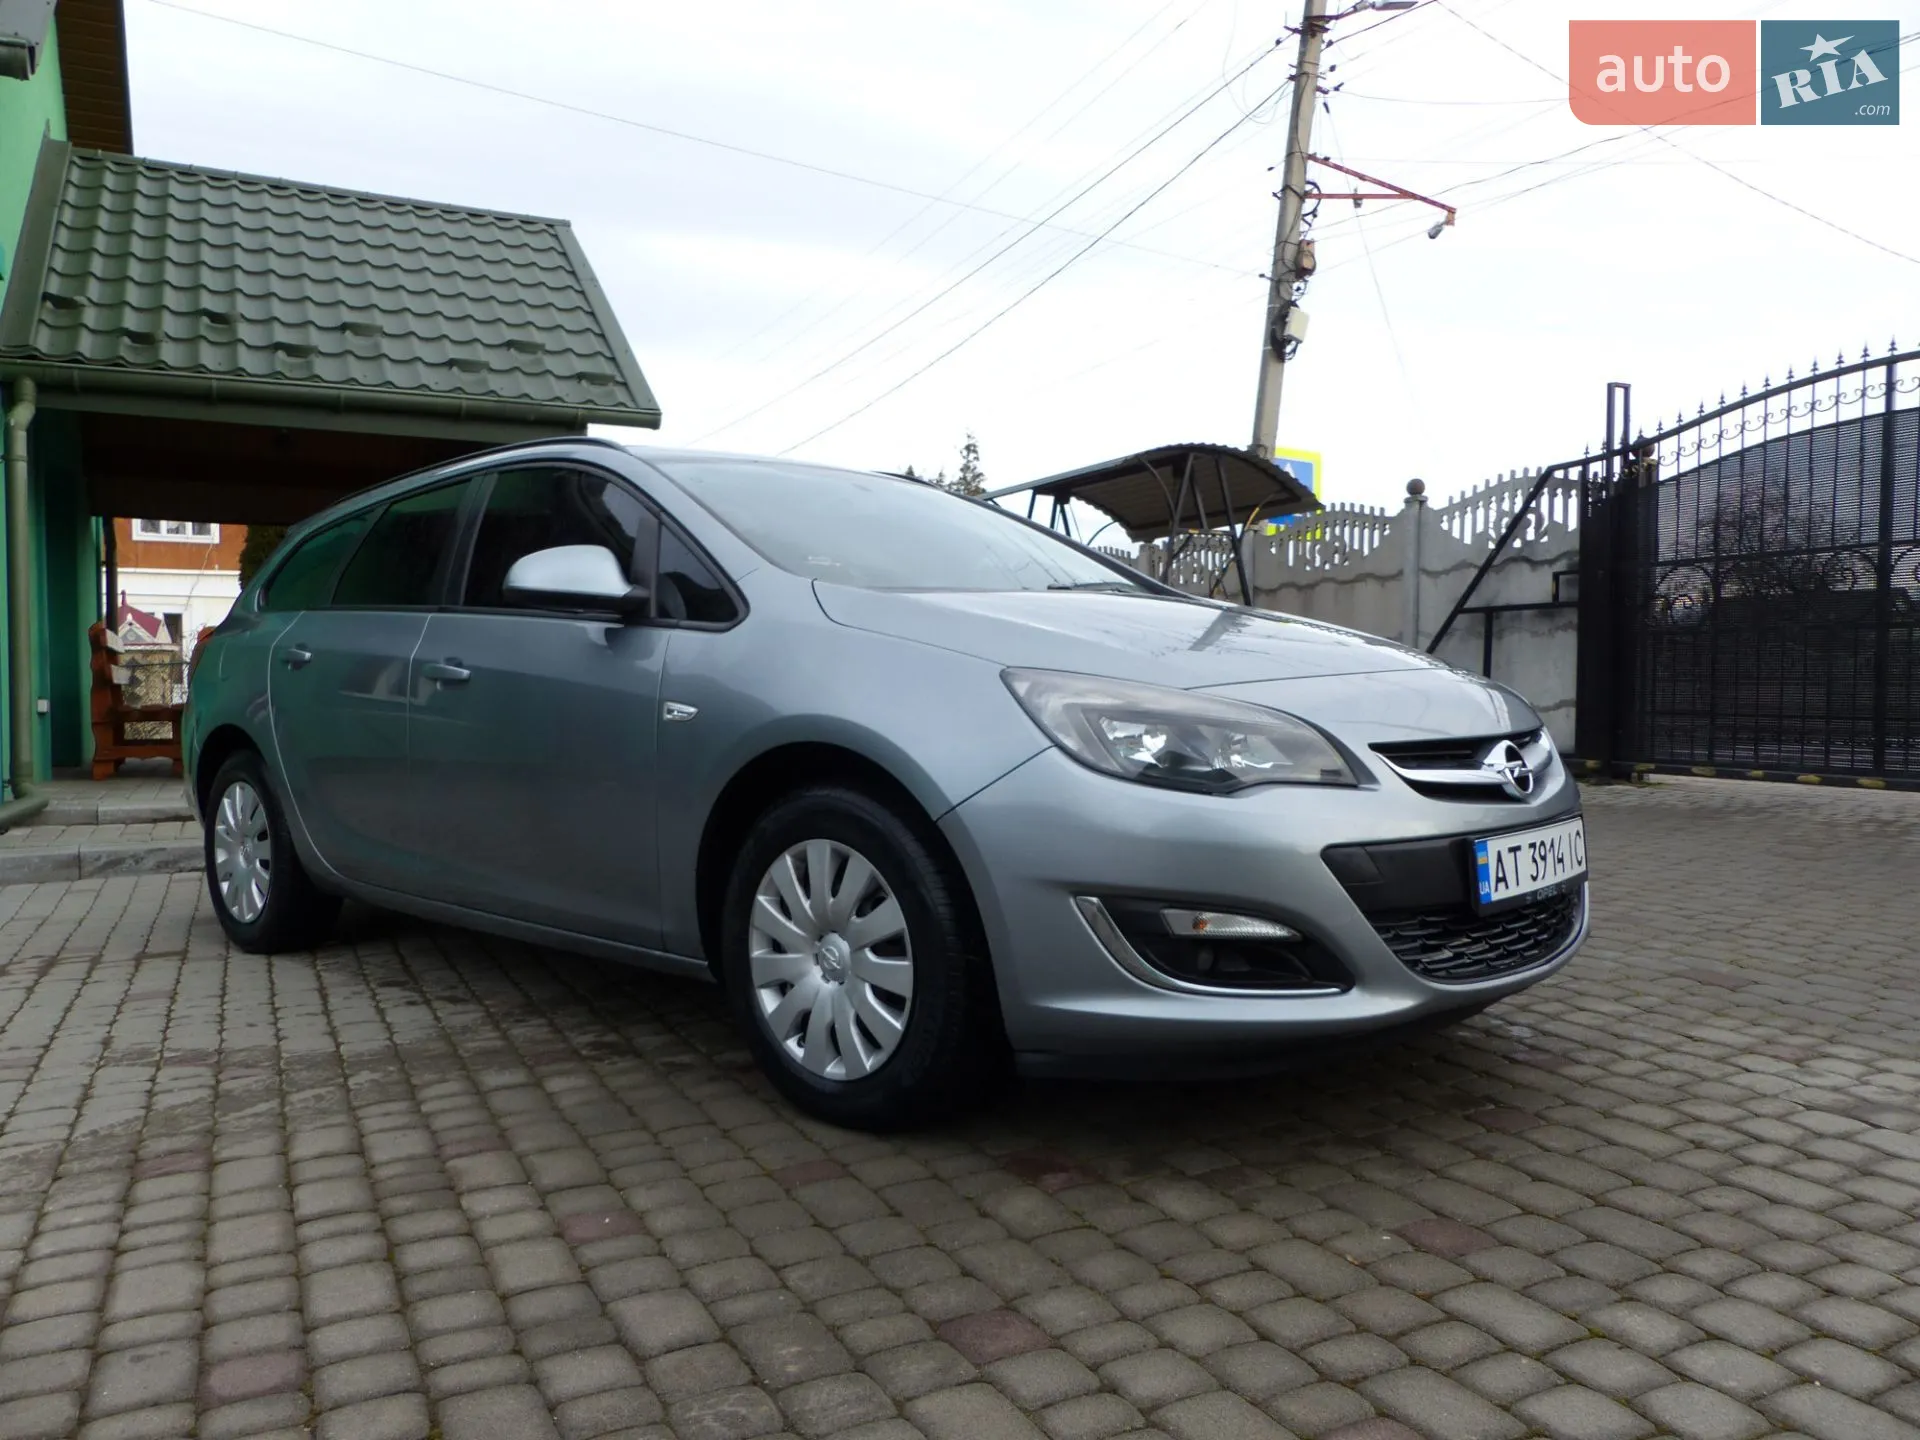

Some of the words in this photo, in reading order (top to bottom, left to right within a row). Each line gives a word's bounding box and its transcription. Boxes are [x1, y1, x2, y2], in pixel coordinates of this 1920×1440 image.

[1494, 845, 1522, 893] AT
[1528, 835, 1565, 882] 3914
[1568, 829, 1583, 870] IC
[1479, 881, 1491, 895] UA
